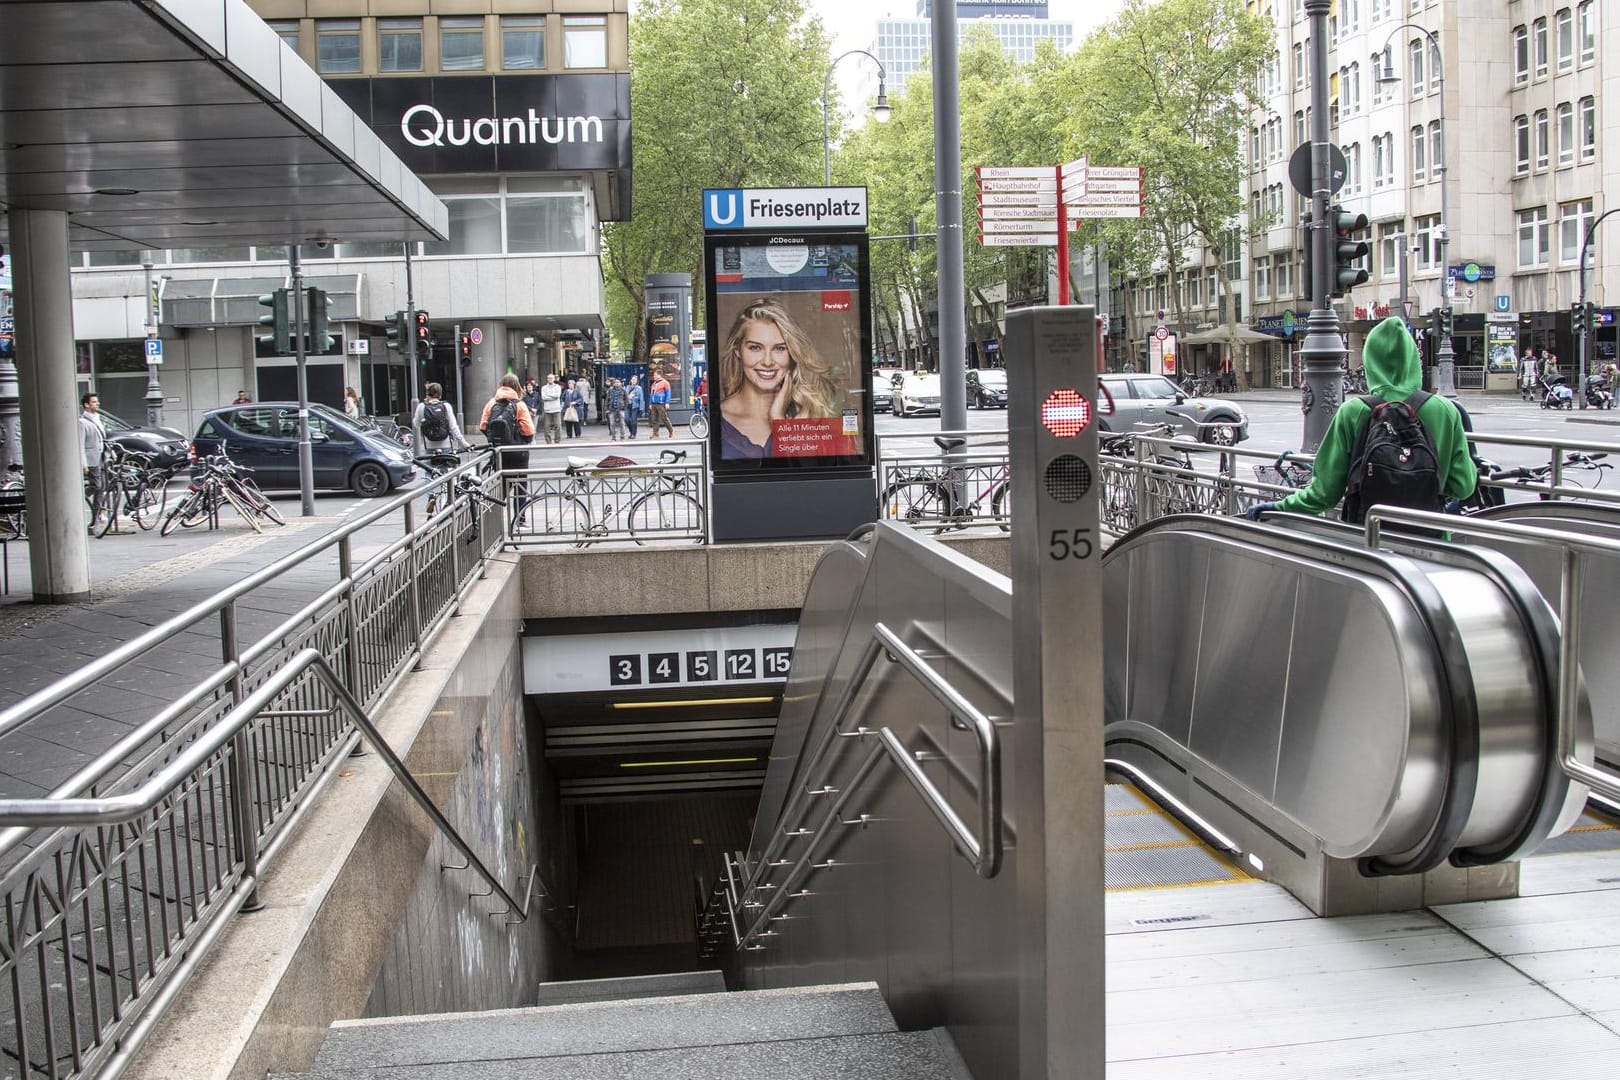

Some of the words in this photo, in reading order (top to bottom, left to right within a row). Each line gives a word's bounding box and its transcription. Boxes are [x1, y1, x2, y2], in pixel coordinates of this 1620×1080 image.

[401, 104, 603, 147] Quantum
[992, 182, 1041, 190] Hauptbahnhof
[711, 194, 736, 225] U
[750, 198, 860, 220] Friesenplatz
[993, 208, 1022, 216] Römische
[1022, 208, 1056, 216] Stadtmauer
[1078, 209, 1118, 217] Friesenplatz
[993, 236, 1039, 244] Friesenviertel
[1498, 297, 1508, 309] U
[147, 343, 157, 355] P
[778, 424, 792, 432] Alle
[778, 444, 800, 453] Single
[1050, 528, 1092, 560] 55
[617, 660, 633, 680] 3
[656, 658, 672, 678] 4
[694, 656, 709, 676] 5
[727, 654, 752, 674] 12
[765, 652, 791, 673] 15
